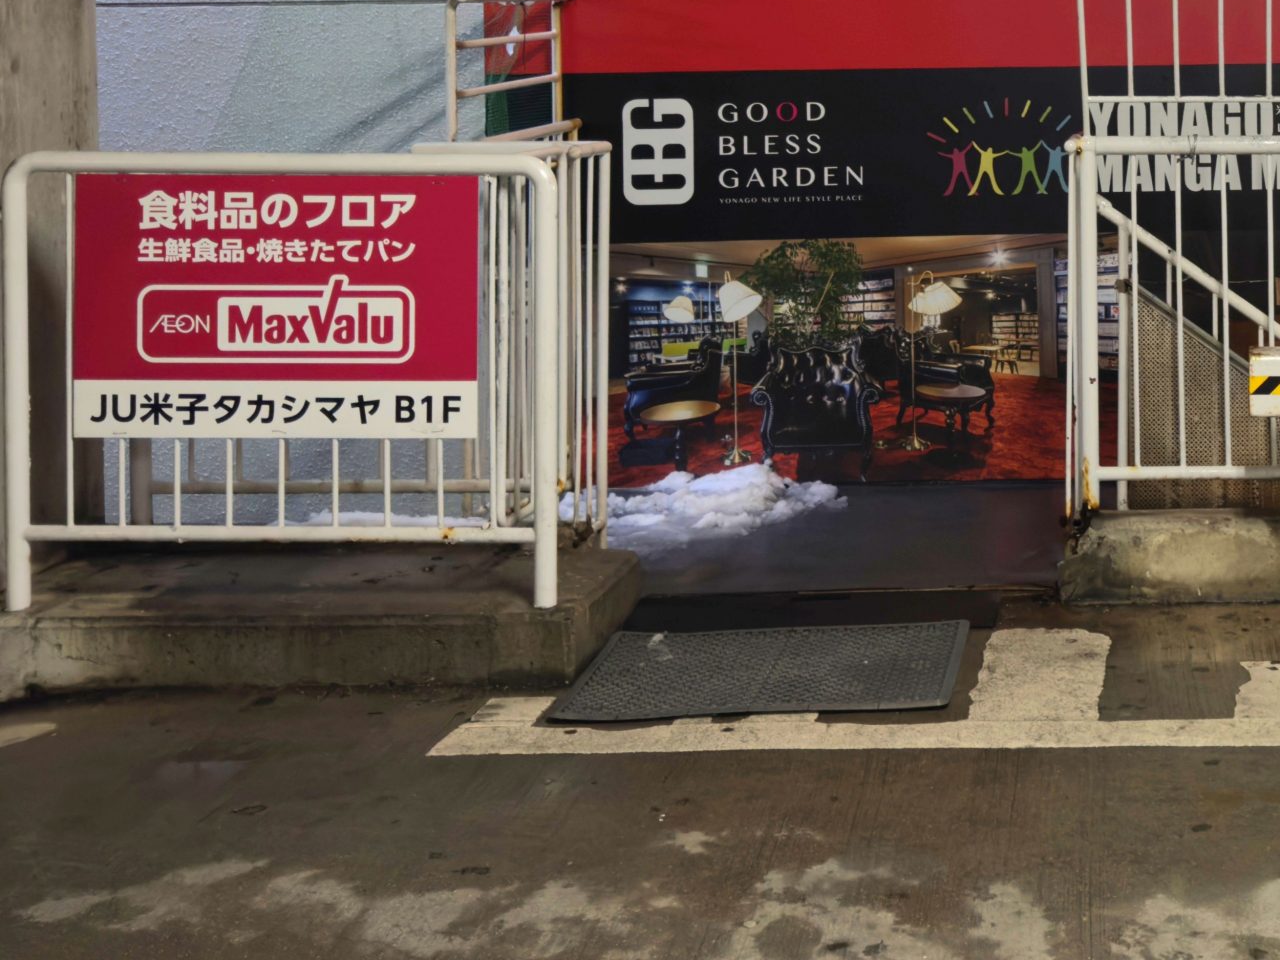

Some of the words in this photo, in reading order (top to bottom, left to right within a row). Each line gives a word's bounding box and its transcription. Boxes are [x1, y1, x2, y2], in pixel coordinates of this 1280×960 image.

[717, 101, 826, 123] GOOD
[1087, 101, 1274, 137] YONAGO
[718, 133, 822, 157] BLESS
[718, 165, 864, 189] GARDEN
[1096, 152, 1243, 193] MANGA
[138, 190, 417, 231] 食料品のフロア
[227, 278, 394, 345] MaxValu
[90, 392, 380, 426] JU米子タカシマヤ
[395, 394, 462, 425] B1F
